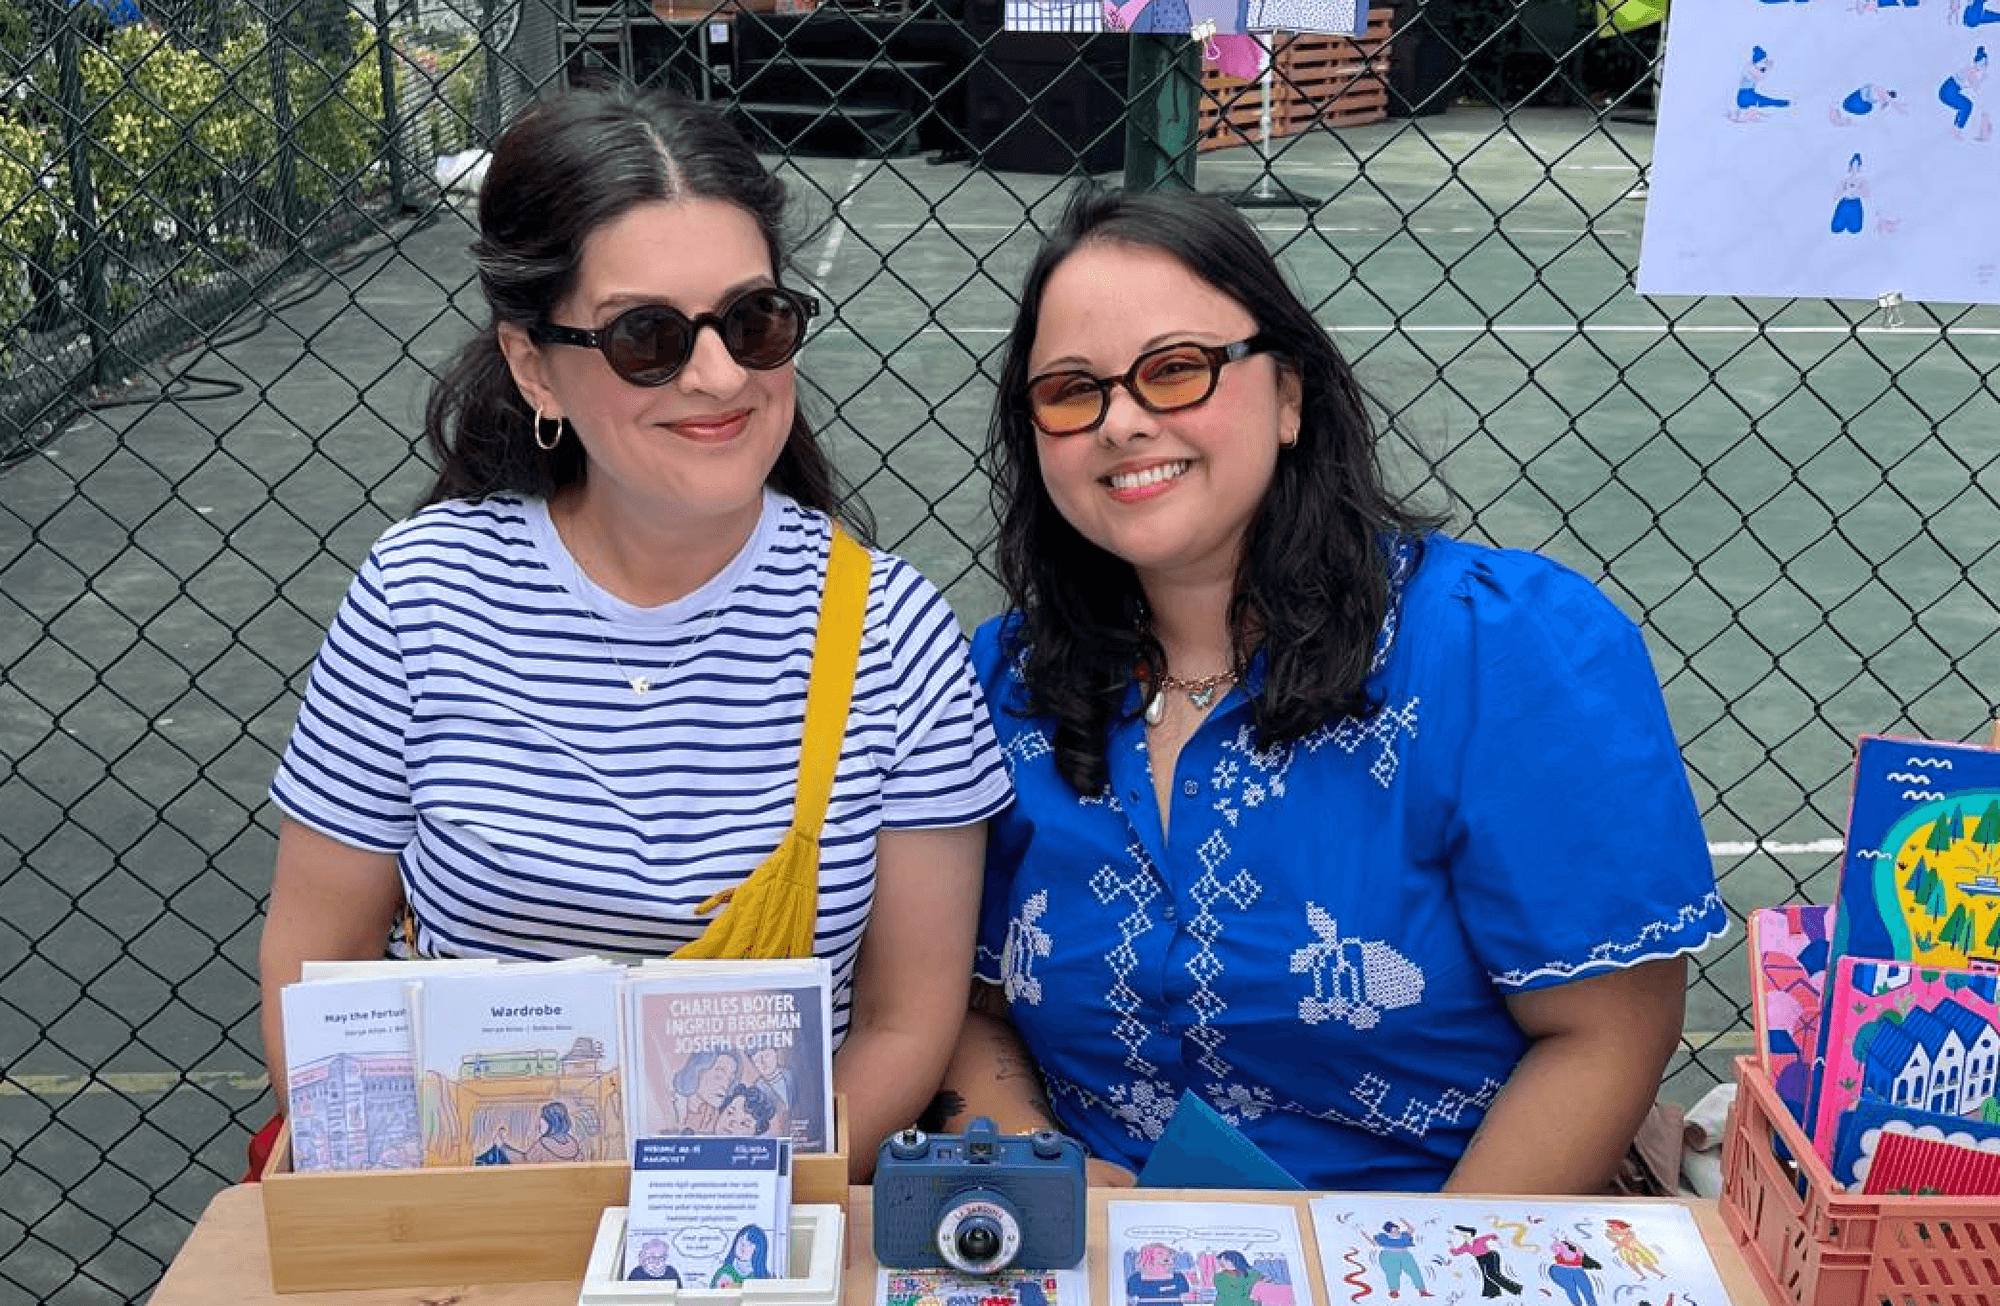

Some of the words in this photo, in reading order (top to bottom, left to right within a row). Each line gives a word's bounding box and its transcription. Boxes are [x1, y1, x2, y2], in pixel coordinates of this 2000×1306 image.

[490, 1004, 562, 1017] Wardrobe
[670, 996, 739, 1017] CHARLES
[743, 993, 795, 1013] BOYER
[665, 1016, 724, 1036] INGRID
[728, 1012, 801, 1033] BERGMAN
[674, 1034, 731, 1054] JOSEPH
[735, 1031, 793, 1051] COTTEN
